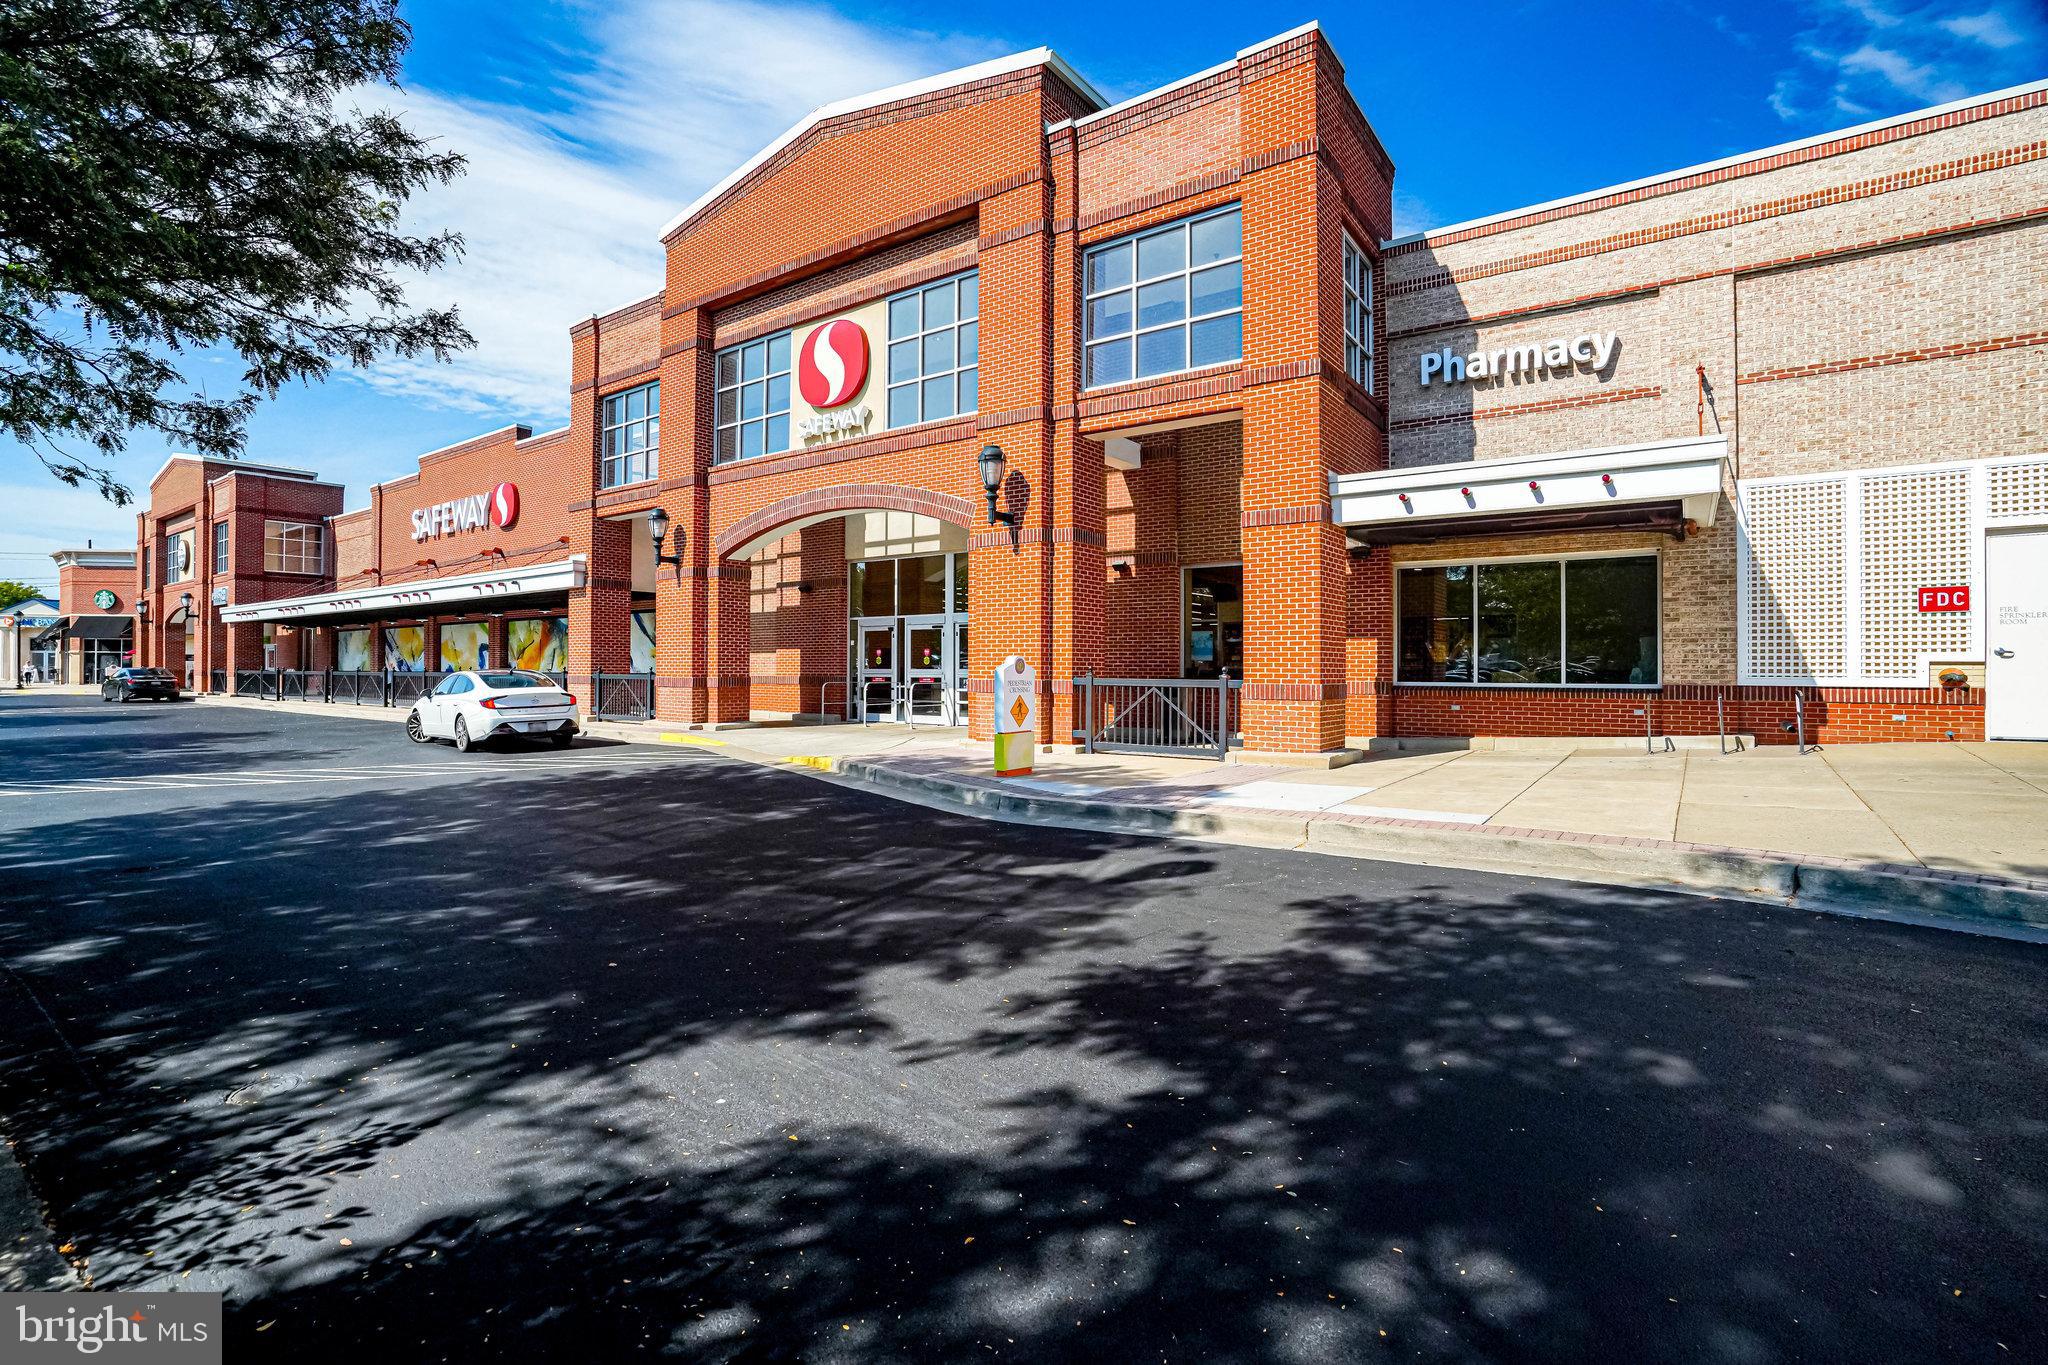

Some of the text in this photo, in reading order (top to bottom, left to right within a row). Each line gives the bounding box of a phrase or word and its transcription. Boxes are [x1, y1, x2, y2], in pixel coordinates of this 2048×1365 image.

[1420, 330, 1619, 386] Pharmacy
[797, 406, 868, 438] SAFEWAY
[411, 491, 491, 540] SAFEWAY
[1922, 591, 1965, 607] FDC
